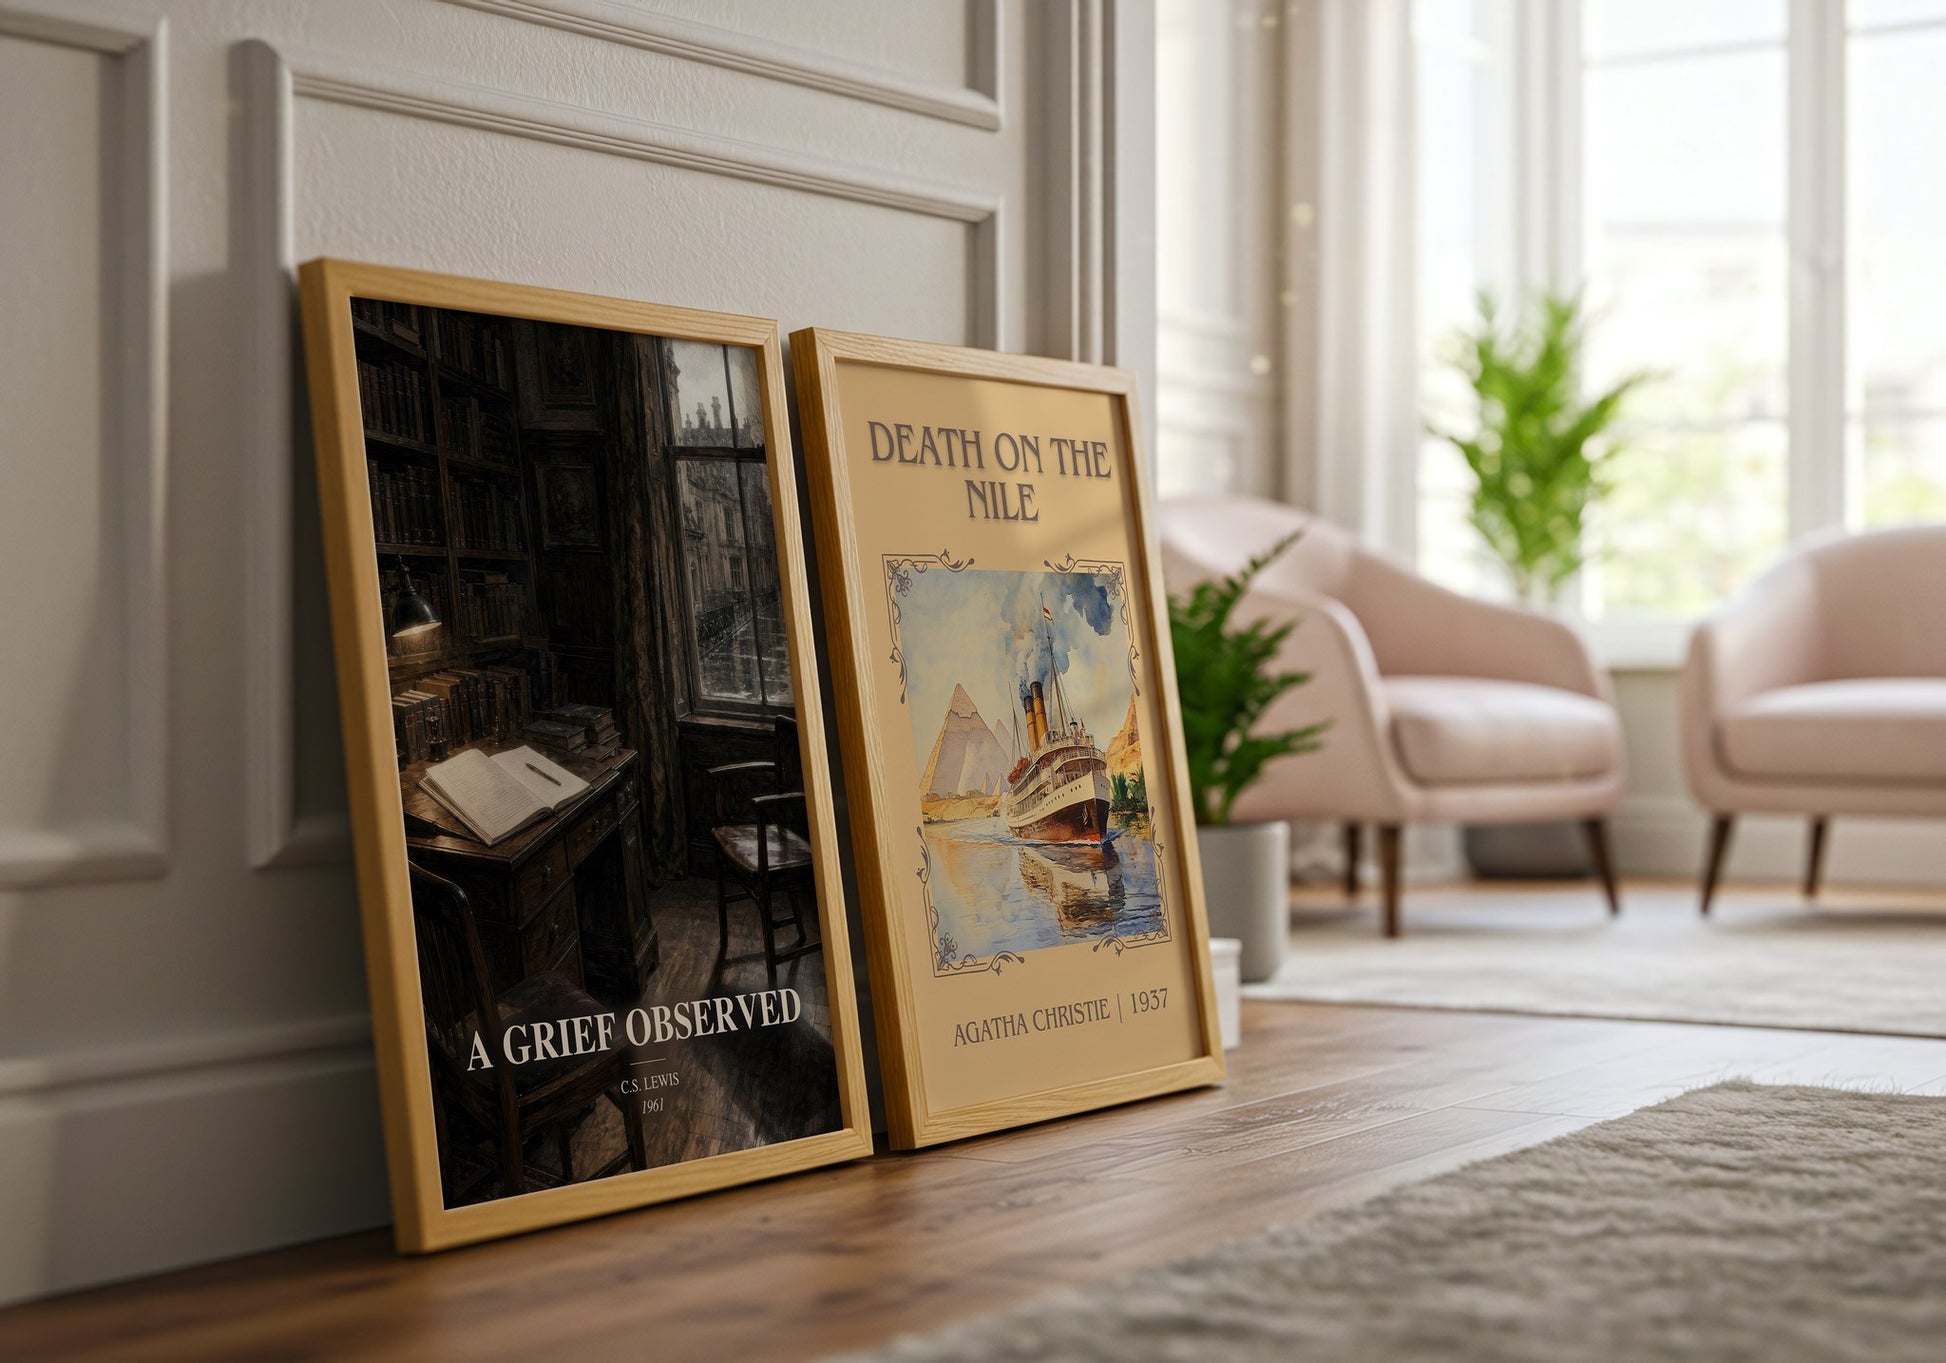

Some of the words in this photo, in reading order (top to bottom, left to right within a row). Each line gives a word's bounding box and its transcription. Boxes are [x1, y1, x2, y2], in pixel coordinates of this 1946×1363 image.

[867, 420, 985, 469] DEATH
[994, 432, 1043, 474] ON
[1050, 437, 1112, 478] THE
[964, 479, 1039, 522] NILE
[467, 1030, 494, 1071] A
[503, 1012, 616, 1065] GRIEF
[625, 988, 801, 1047] OBSERVED
[954, 1013, 1029, 1047] AGATHA
[1033, 998, 1111, 1032] CHRISTIE
[1130, 988, 1168, 1015] 1937
[620, 1078, 642, 1095] C.S.
[644, 1072, 680, 1091] LEWIS
[641, 1098, 664, 1114] 1961
